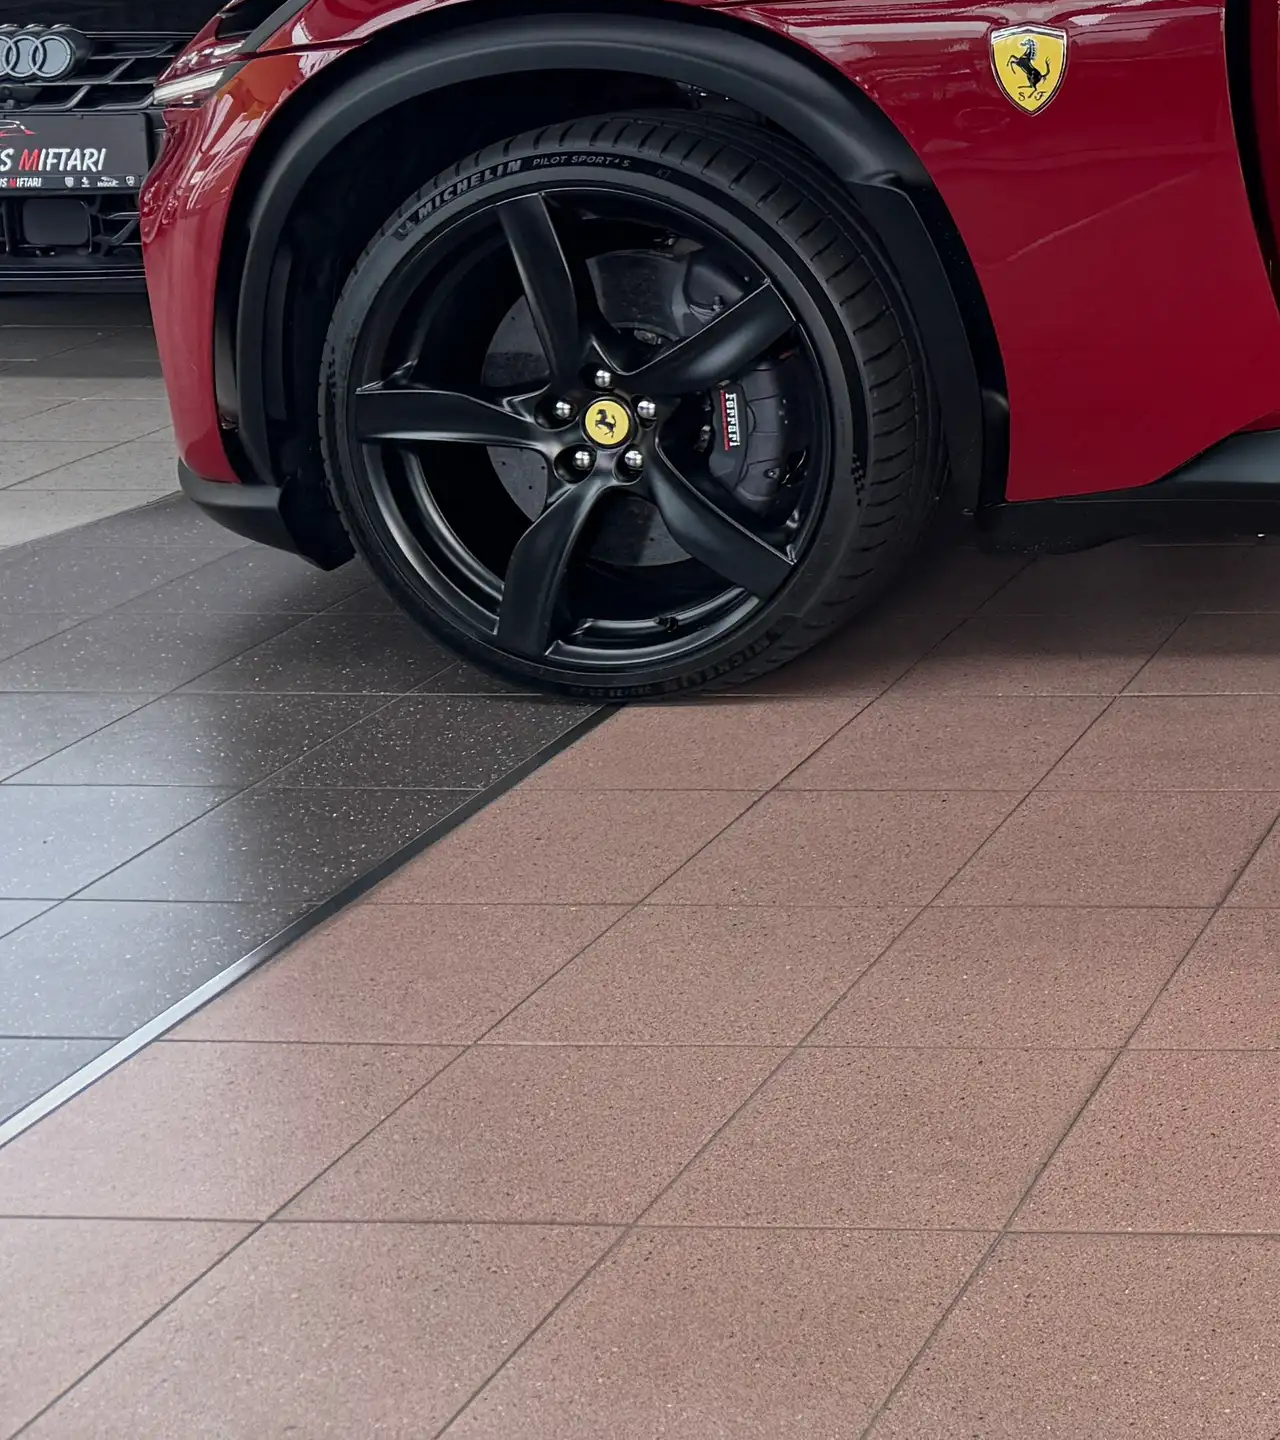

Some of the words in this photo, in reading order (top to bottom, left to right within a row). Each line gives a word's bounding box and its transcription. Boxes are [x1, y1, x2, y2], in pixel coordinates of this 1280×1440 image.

[0, 148, 14, 172] S
[18, 147, 107, 172] MIFTARI
[8, 177, 42, 188] MIFTARI
[417, 159, 524, 221] MICHELIN
[532, 155, 568, 166] PILOT
[571, 154, 611, 165] SPORT
[725, 393, 741, 447] Ferrari
